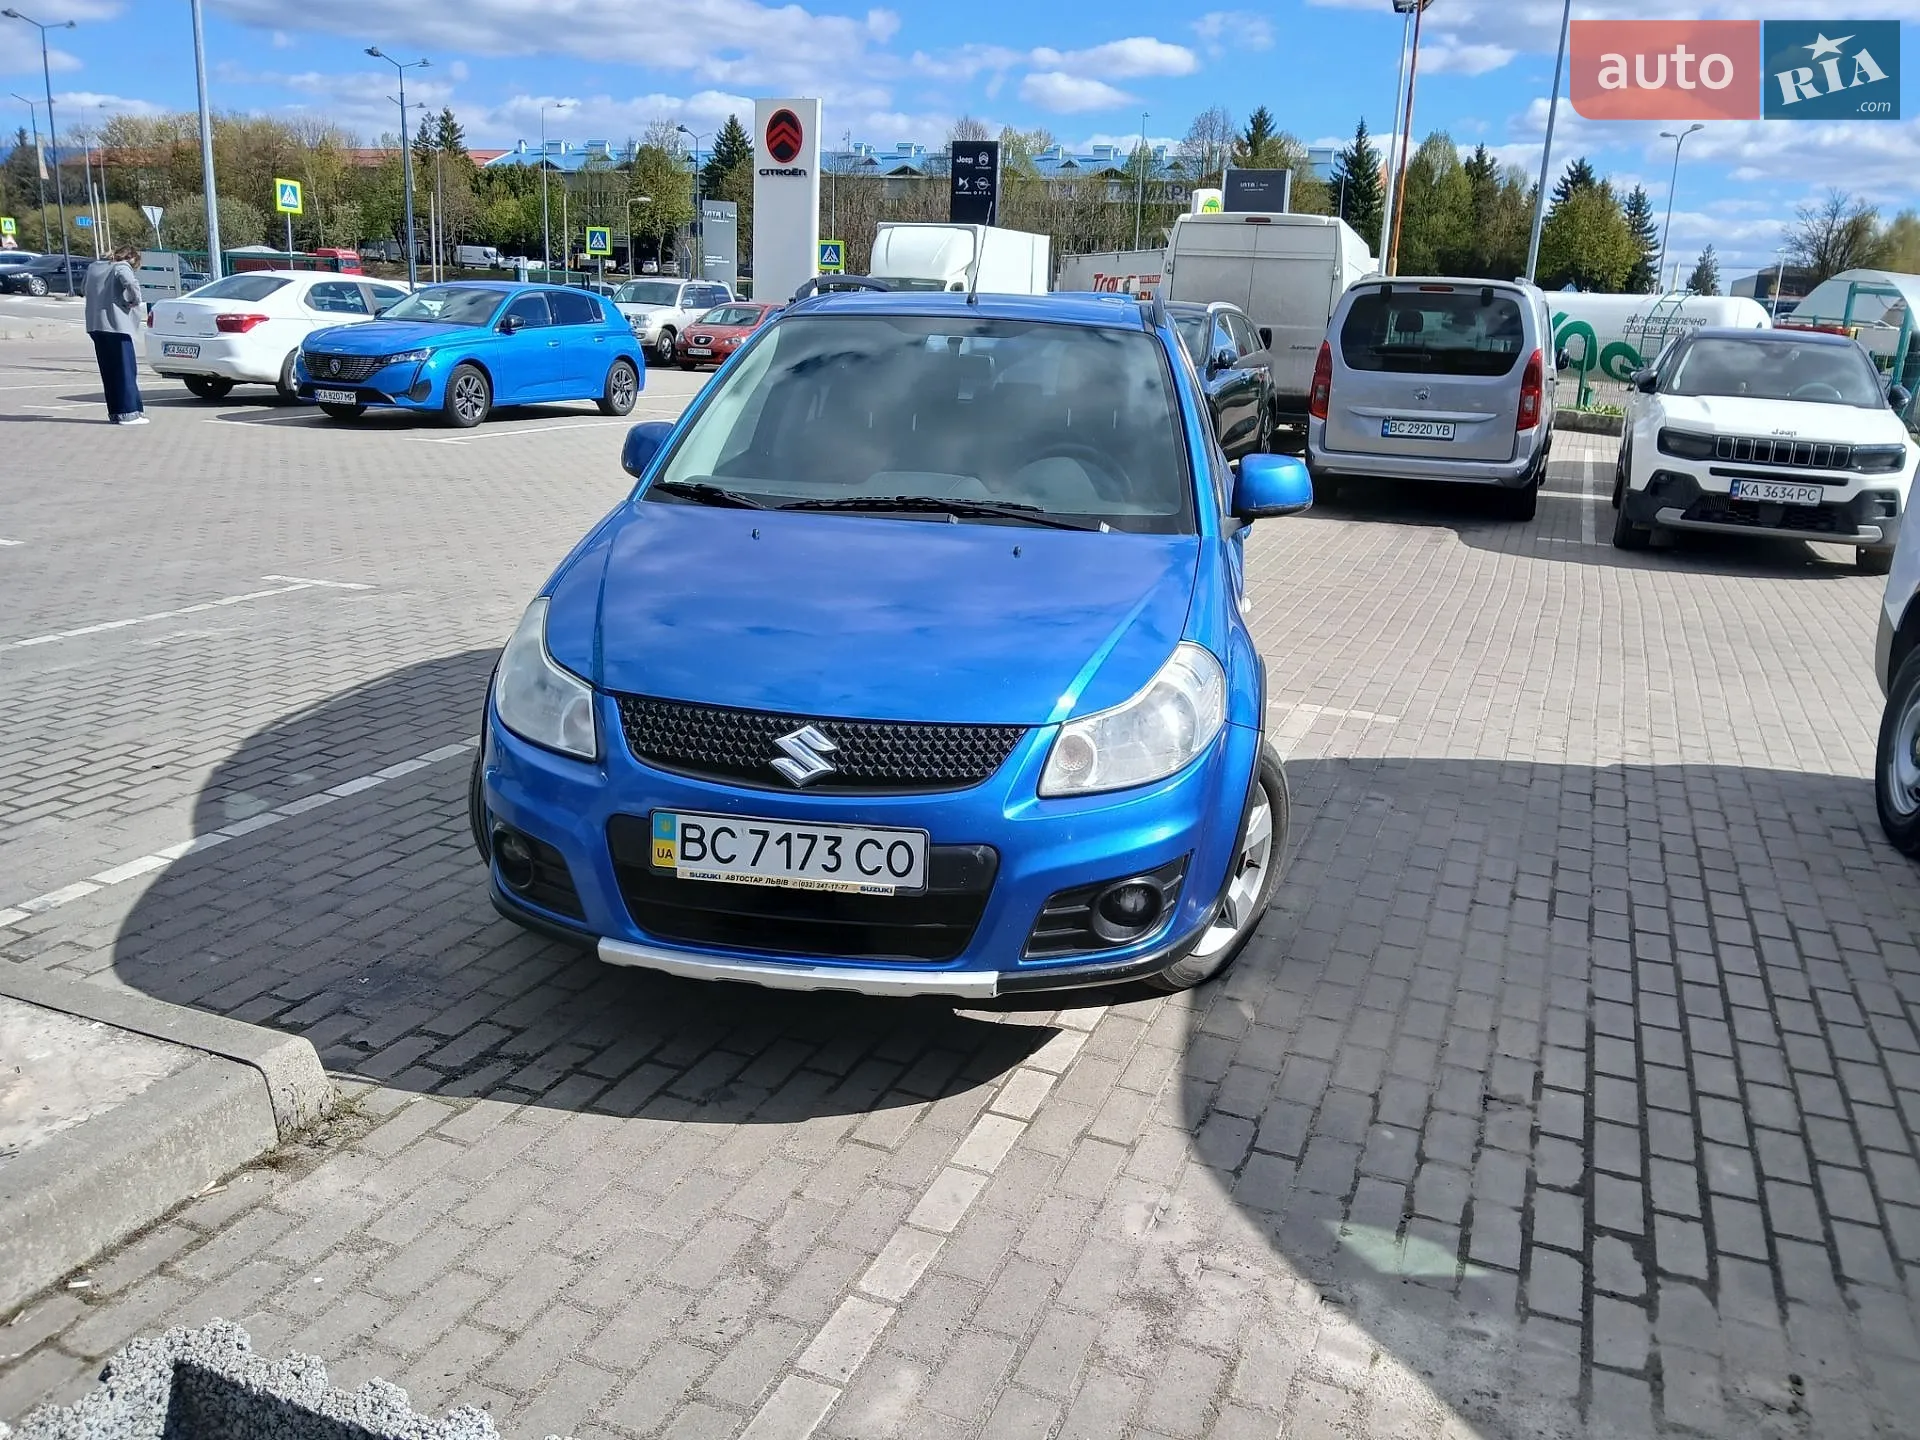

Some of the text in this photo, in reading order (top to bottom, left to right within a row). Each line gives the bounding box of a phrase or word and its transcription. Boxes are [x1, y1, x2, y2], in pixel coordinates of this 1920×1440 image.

[956, 156, 974, 164] Jeep
[1389, 422, 1450, 436] BC 2920 YB
[1771, 429, 1798, 438] Jeep
[1740, 483, 1818, 502] KA 3634 PC
[656, 847, 674, 860] UA
[680, 822, 915, 878] BC 7173 CO
[689, 871, 722, 880] SUZUKI
[725, 874, 763, 884] АВТОСТАР
[764, 877, 789, 887] ЛЬВІВ
[860, 885, 893, 894] SUZUKI
